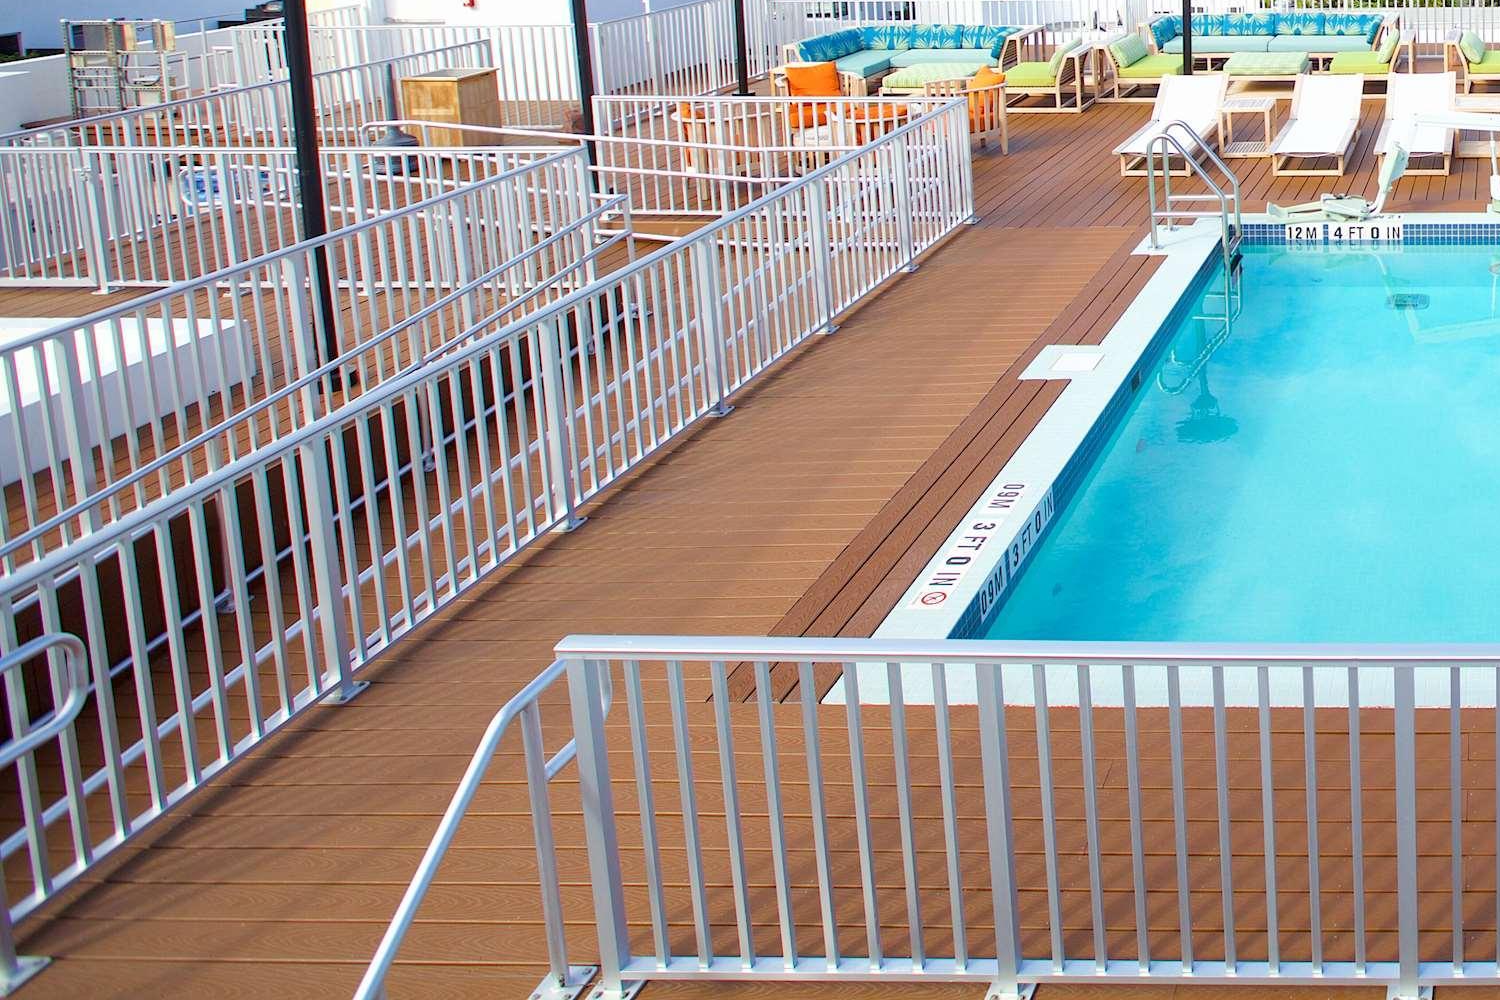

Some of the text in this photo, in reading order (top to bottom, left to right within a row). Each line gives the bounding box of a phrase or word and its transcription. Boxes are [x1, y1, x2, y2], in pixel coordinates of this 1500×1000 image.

[1334, 226, 1343, 240] 4
[1349, 226, 1365, 240] FT
[1386, 226, 1401, 240] IN
[973, 522, 997, 531] 3
[1012, 543, 1020, 568] 3
[1021, 522, 1033, 555] FT
[1044, 494, 1054, 521] IN
[957, 535, 988, 551] FT
[928, 571, 961, 586] IN
